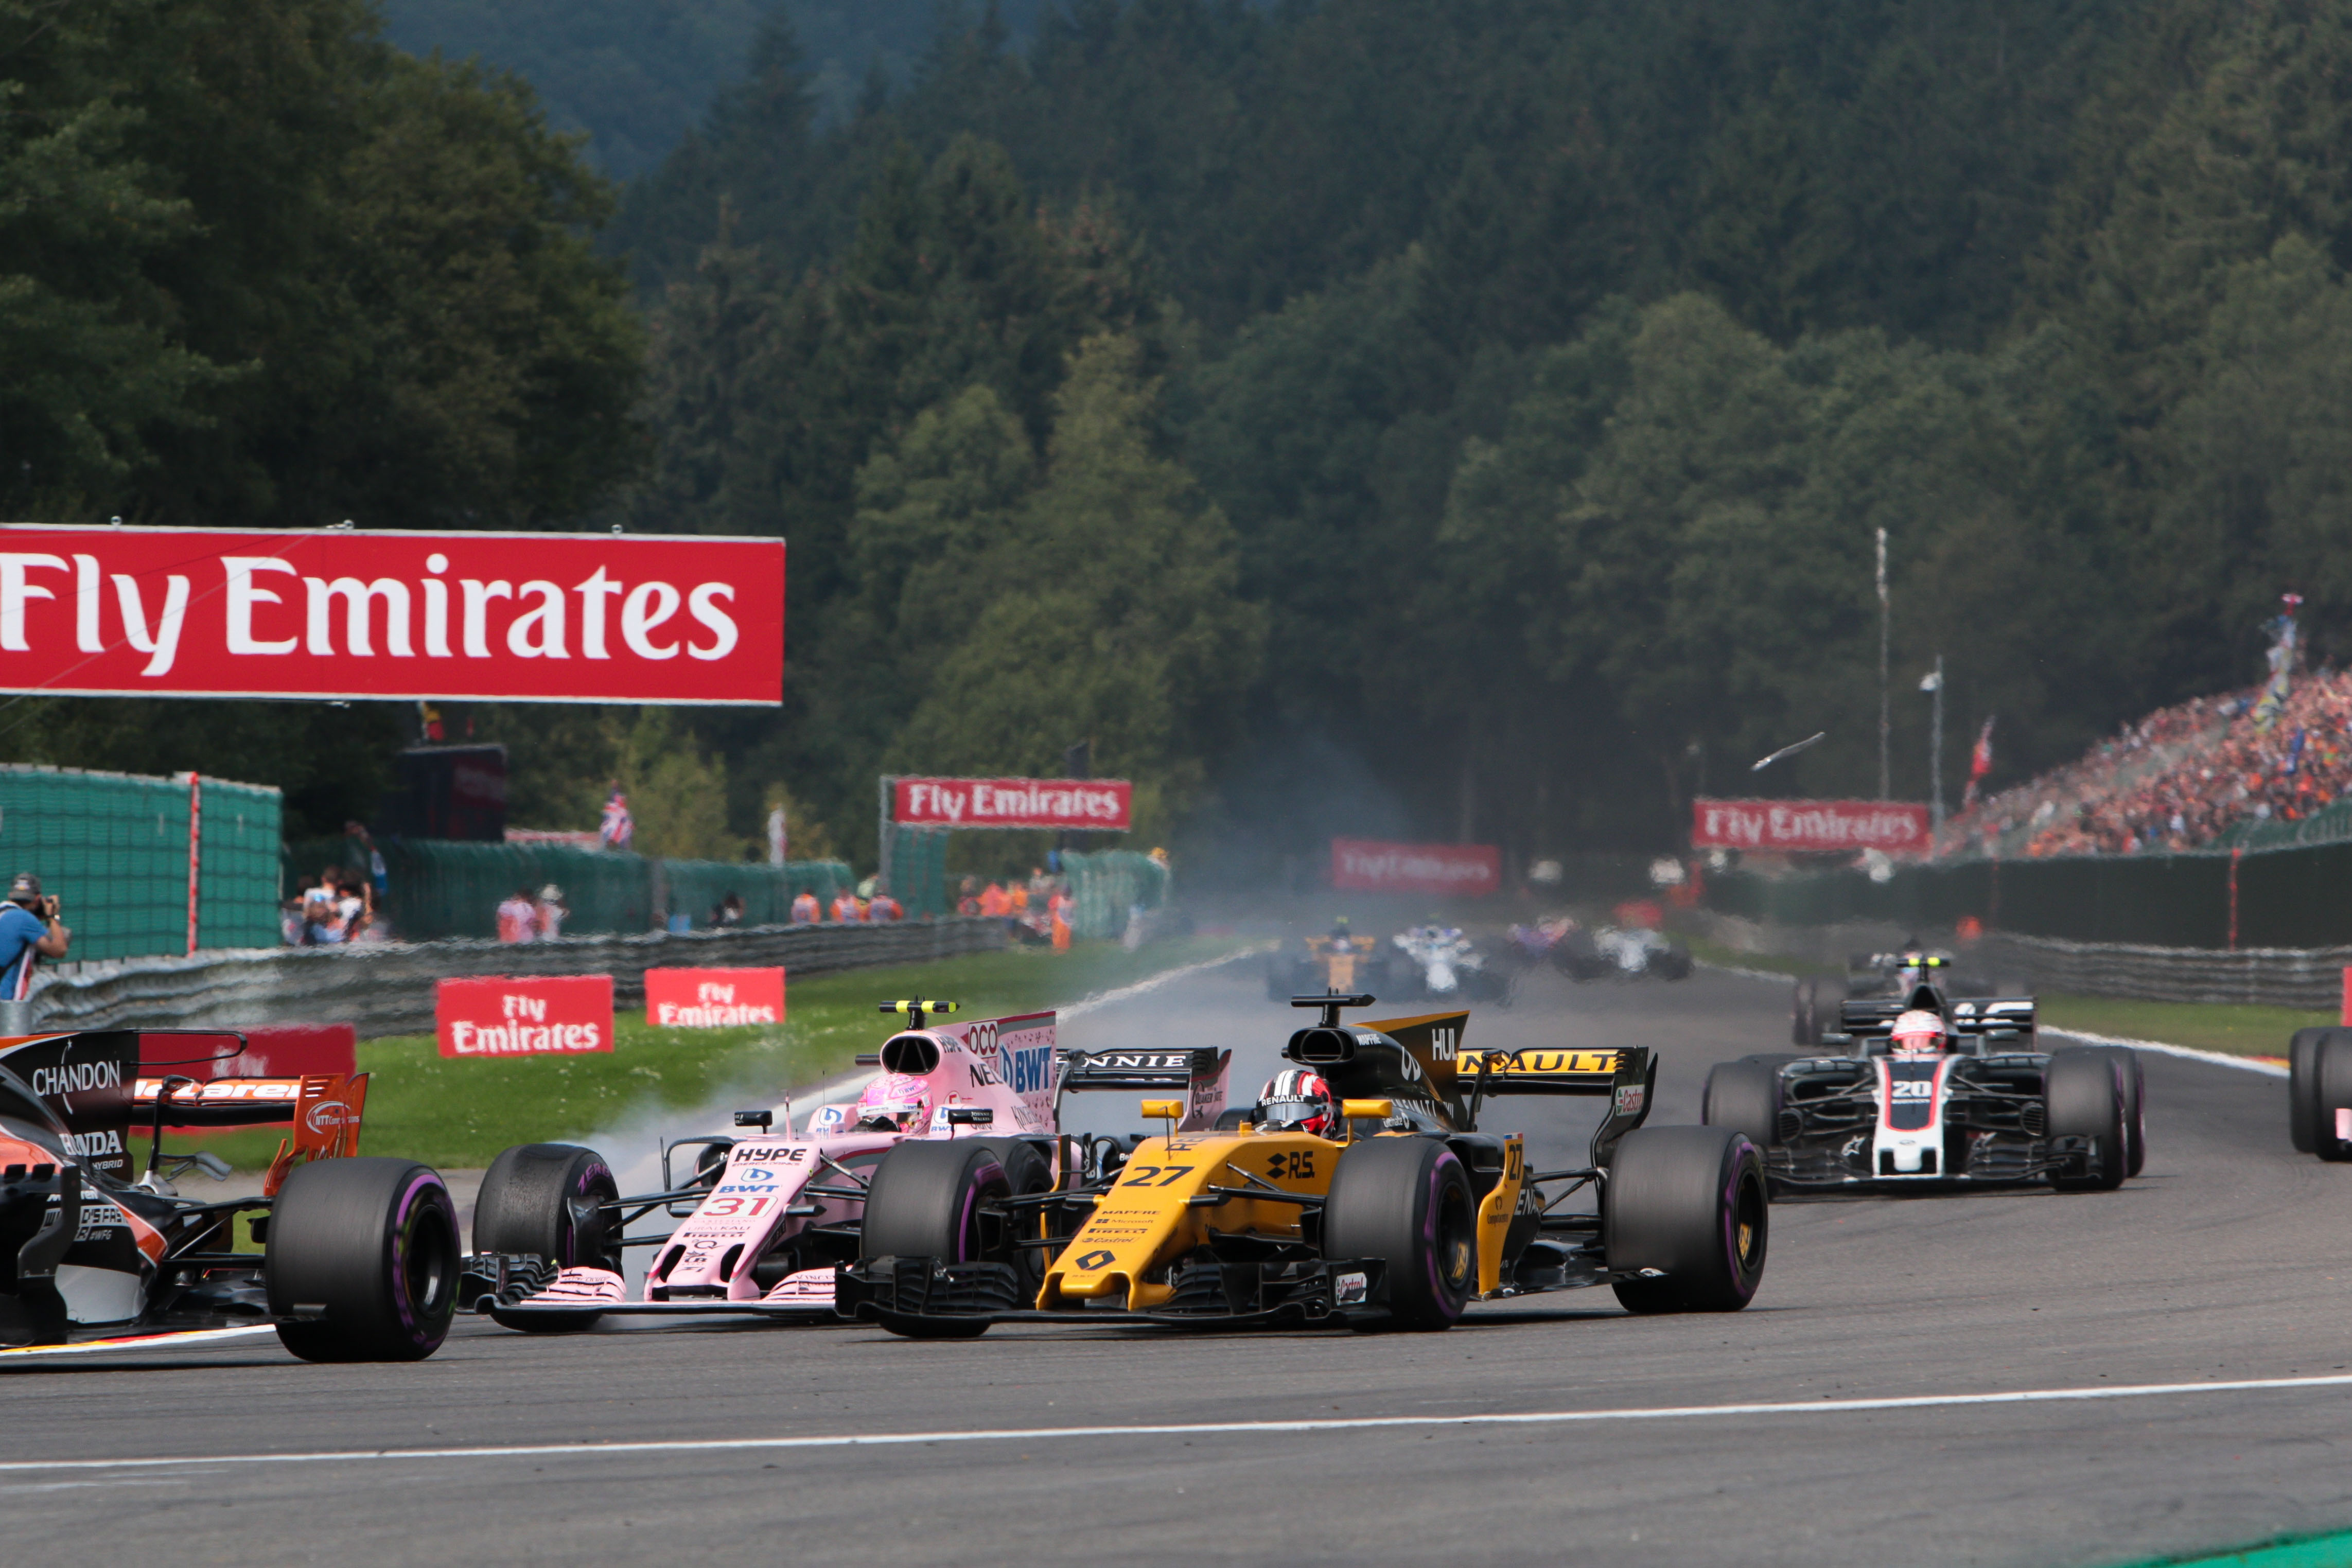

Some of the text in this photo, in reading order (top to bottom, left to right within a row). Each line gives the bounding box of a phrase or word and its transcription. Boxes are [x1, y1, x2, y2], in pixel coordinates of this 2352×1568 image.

[0, 553, 739, 676] Fly Emirates
[909, 782, 1120, 822] Fly Emirates
[698, 982, 736, 1004] Fly
[503, 994, 546, 1022] Fly
[658, 1001, 776, 1028] Emirates
[451, 1019, 600, 1054] Emirates
[970, 1023, 997, 1055] OCO
[33, 1060, 120, 1097] CHANDON
[1015, 1046, 1051, 1093] BWT
[1261, 1095, 1306, 1106] RENAULT
[1892, 1081, 1933, 1097] 20
[92, 1159, 123, 1170] HYBRID
[734, 1148, 807, 1162] HYPE
[1509, 1144, 1522, 1180] 27
[718, 1185, 779, 1193] BWT
[1121, 1166, 1195, 1186] 27
[704, 1197, 769, 1216] 31
